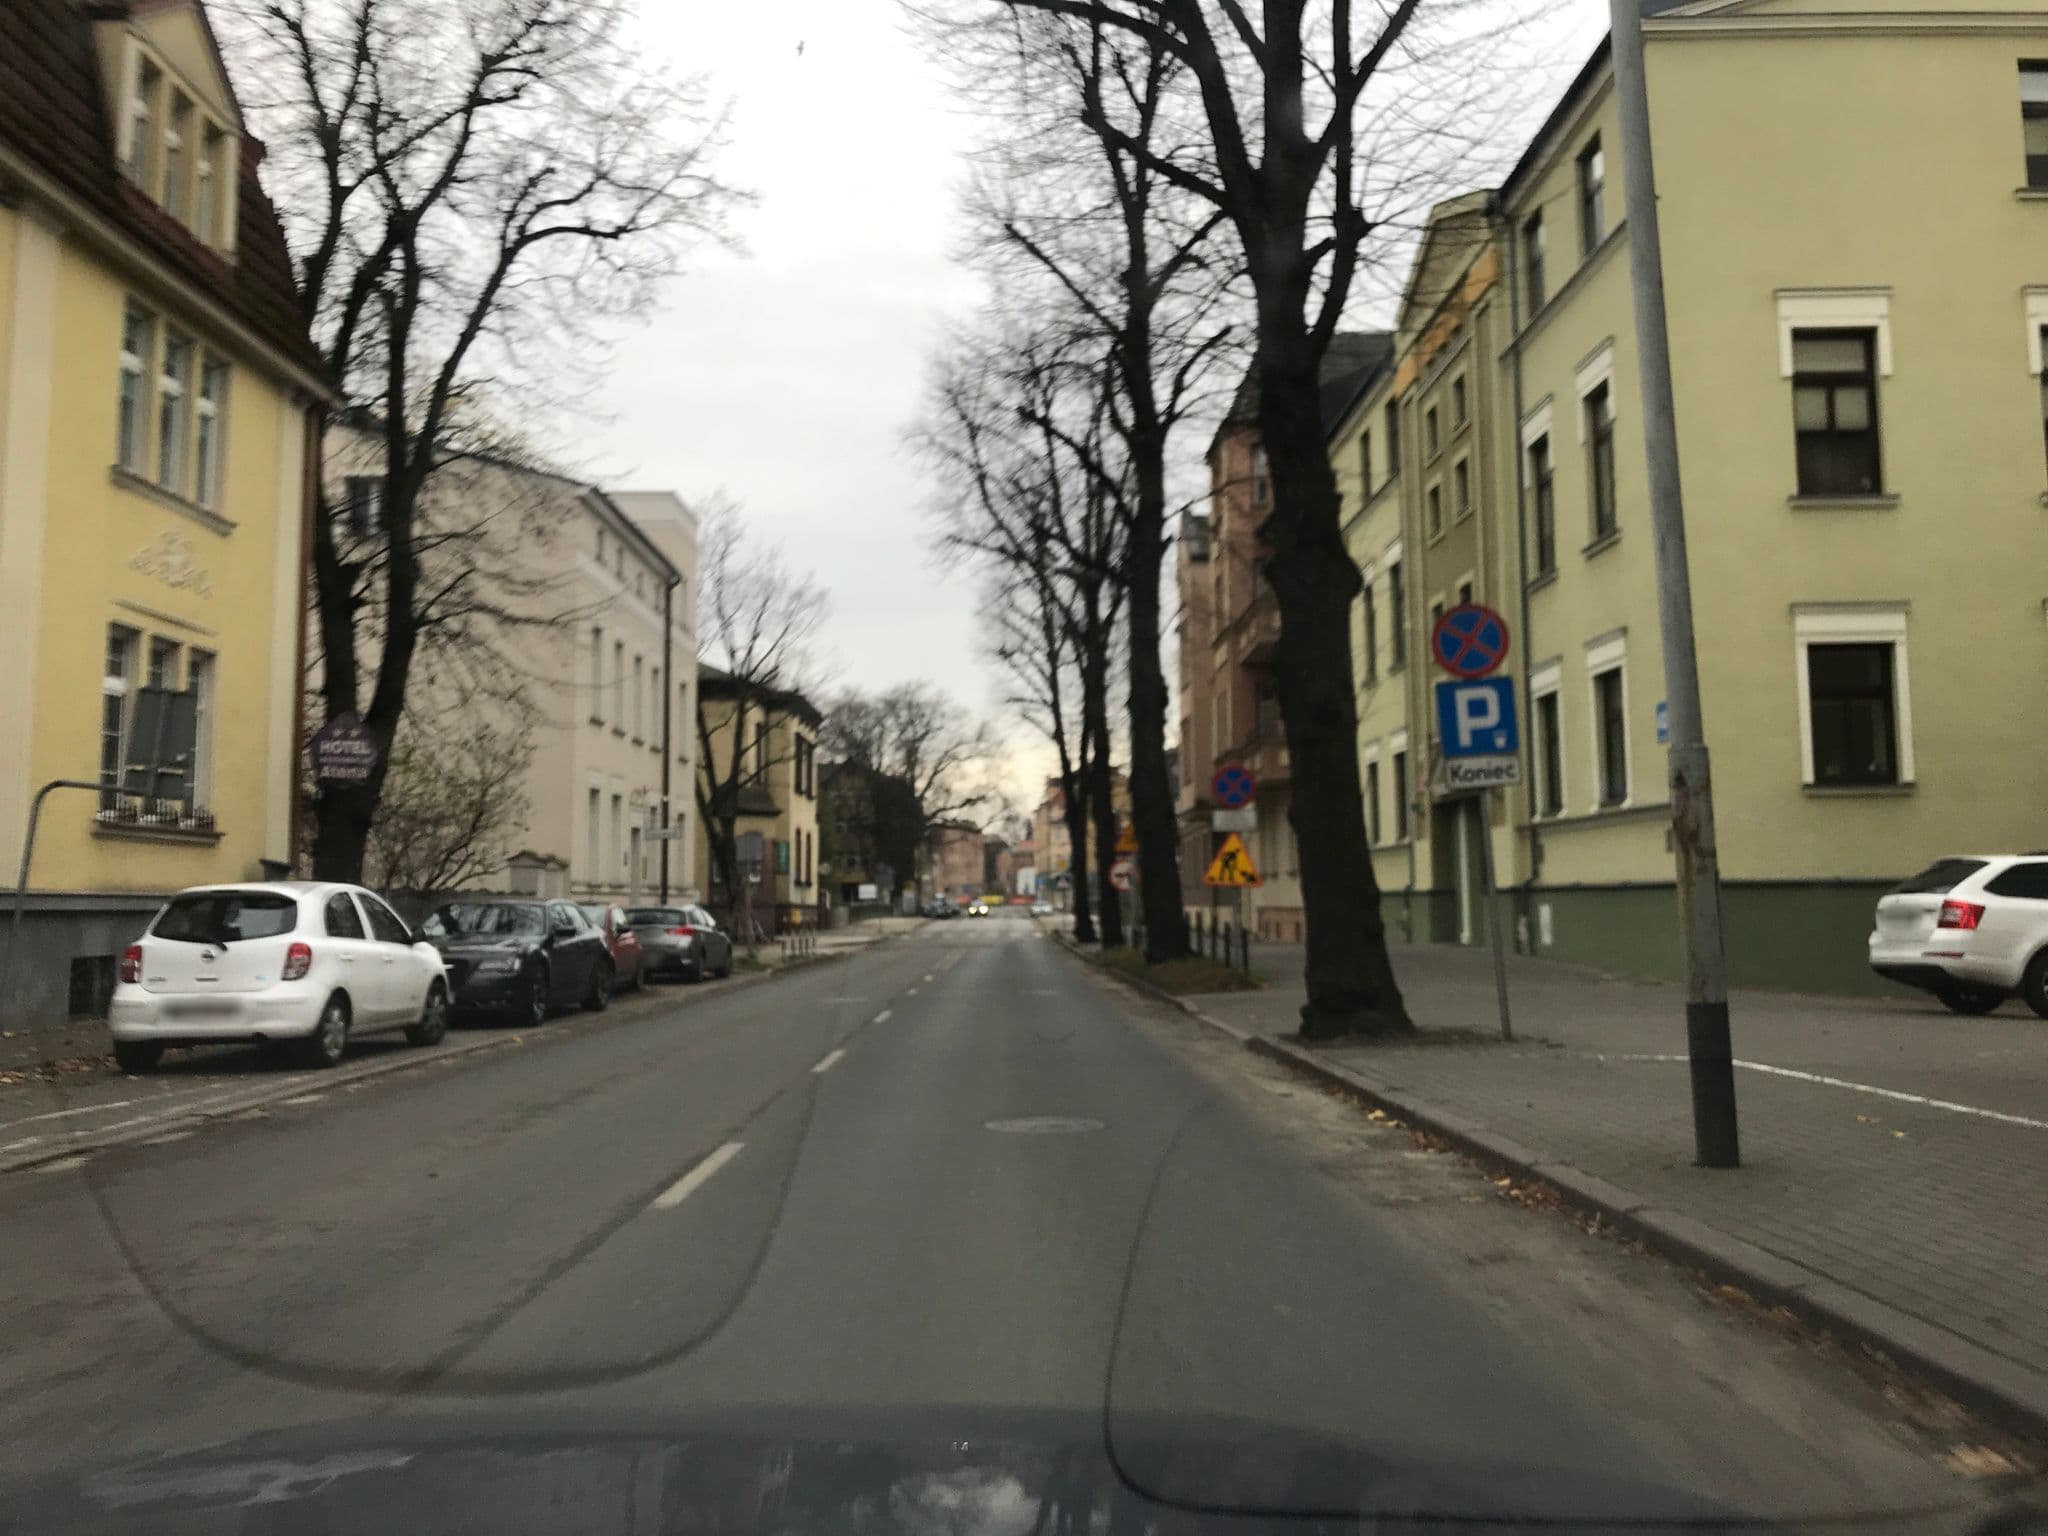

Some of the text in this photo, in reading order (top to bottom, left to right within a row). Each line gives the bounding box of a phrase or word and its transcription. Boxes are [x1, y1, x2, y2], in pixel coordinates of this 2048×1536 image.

[1455, 687, 1500, 747] P
[320, 741, 370, 754] HOTEL
[1451, 761, 1515, 782] Koniec
